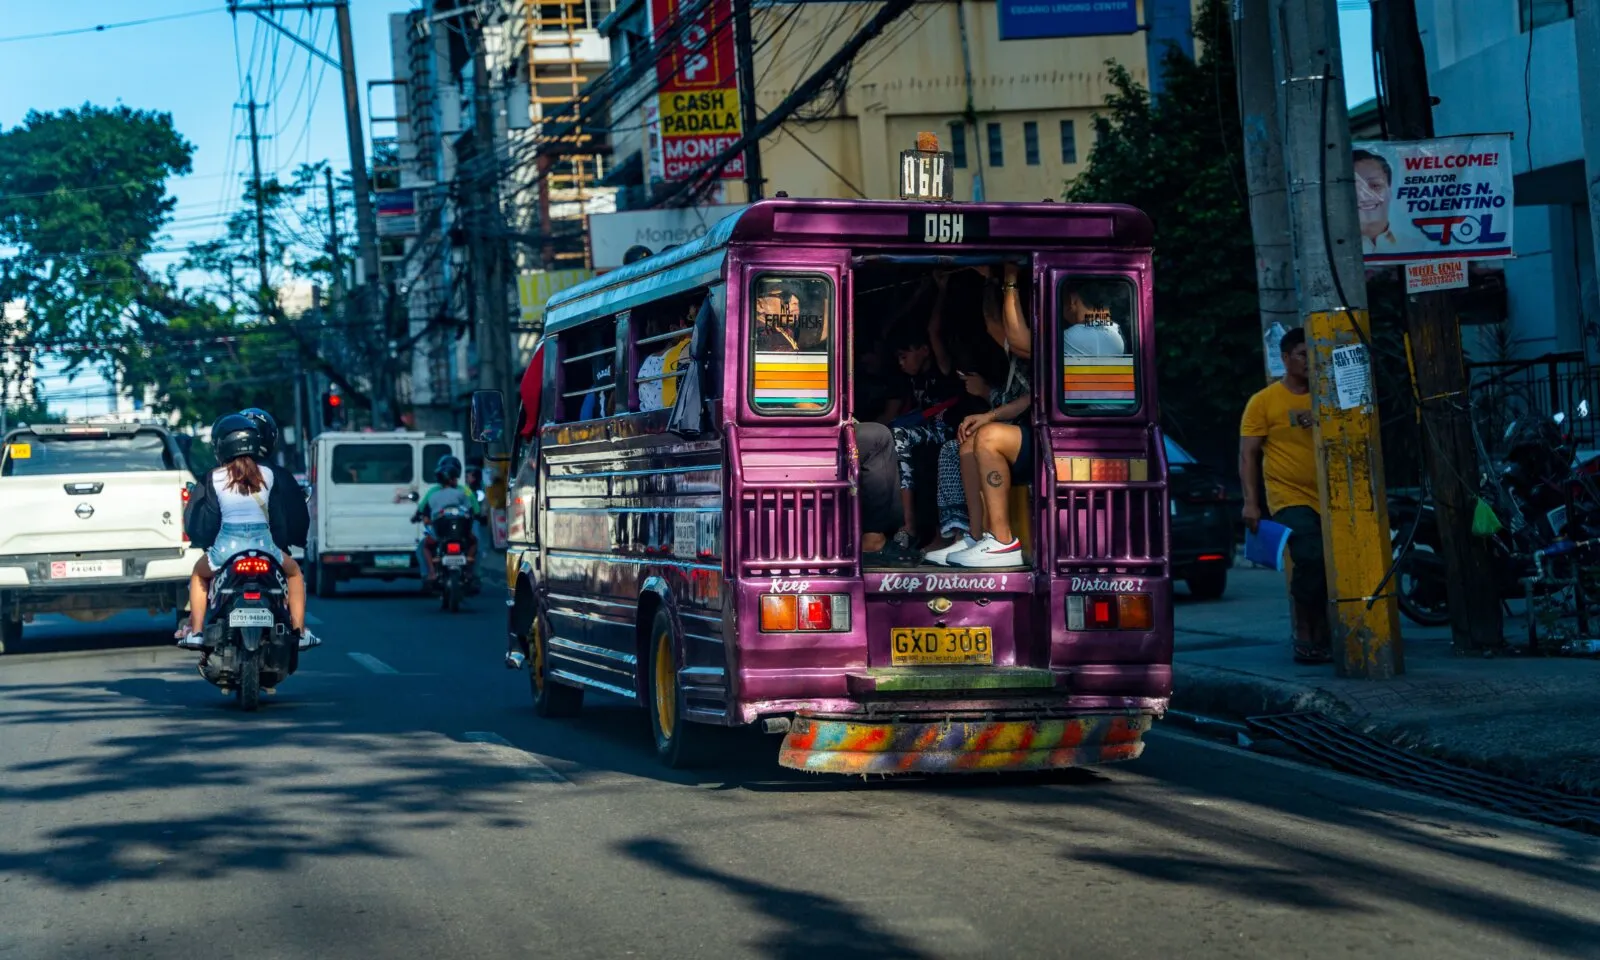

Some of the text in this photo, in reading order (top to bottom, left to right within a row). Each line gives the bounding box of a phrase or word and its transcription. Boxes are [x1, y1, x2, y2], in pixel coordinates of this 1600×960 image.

[673, 93, 724, 112] CASH
[663, 112, 737, 132] PADALA
[1404, 153, 1499, 171] WELCOME!
[1404, 174, 1456, 184] SENATOR
[1396, 182, 1493, 199] FRANCIS N.
[1406, 195, 1505, 212] TOLENTINO
[1411, 214, 1506, 245] TOL
[769, 578, 810, 594] Keep
[879, 573, 922, 592] Keep
[896, 632, 987, 653] GXD 308
